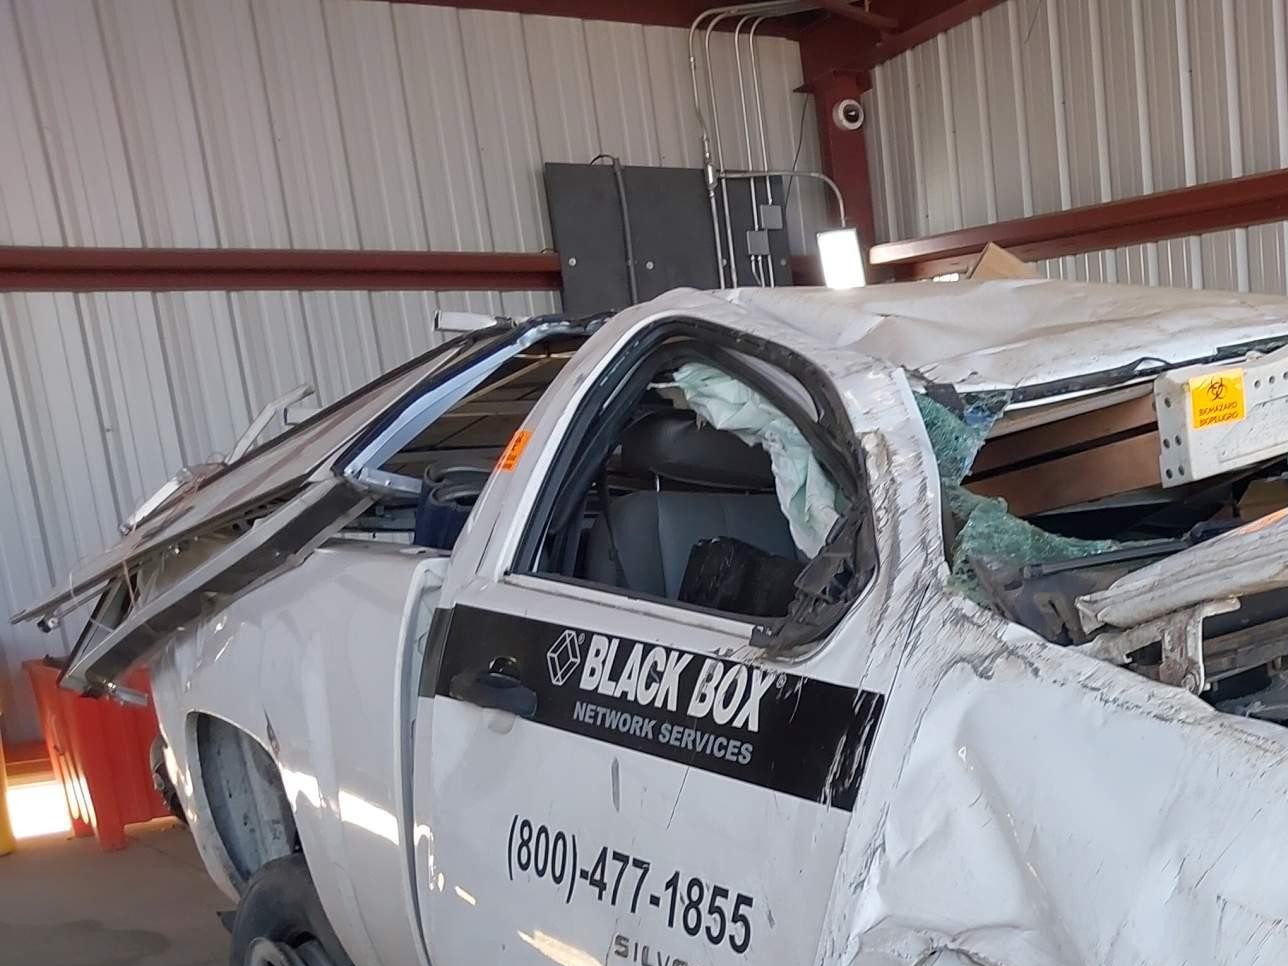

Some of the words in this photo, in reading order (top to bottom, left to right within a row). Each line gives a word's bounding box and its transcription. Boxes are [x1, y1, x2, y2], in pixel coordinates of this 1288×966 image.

[578, 634, 694, 712] BLACK
[572, 701, 657, 740] NETWORK
[657, 723, 754, 766] SERVICES
[507, 814, 754, 954] (800)-477-1855
